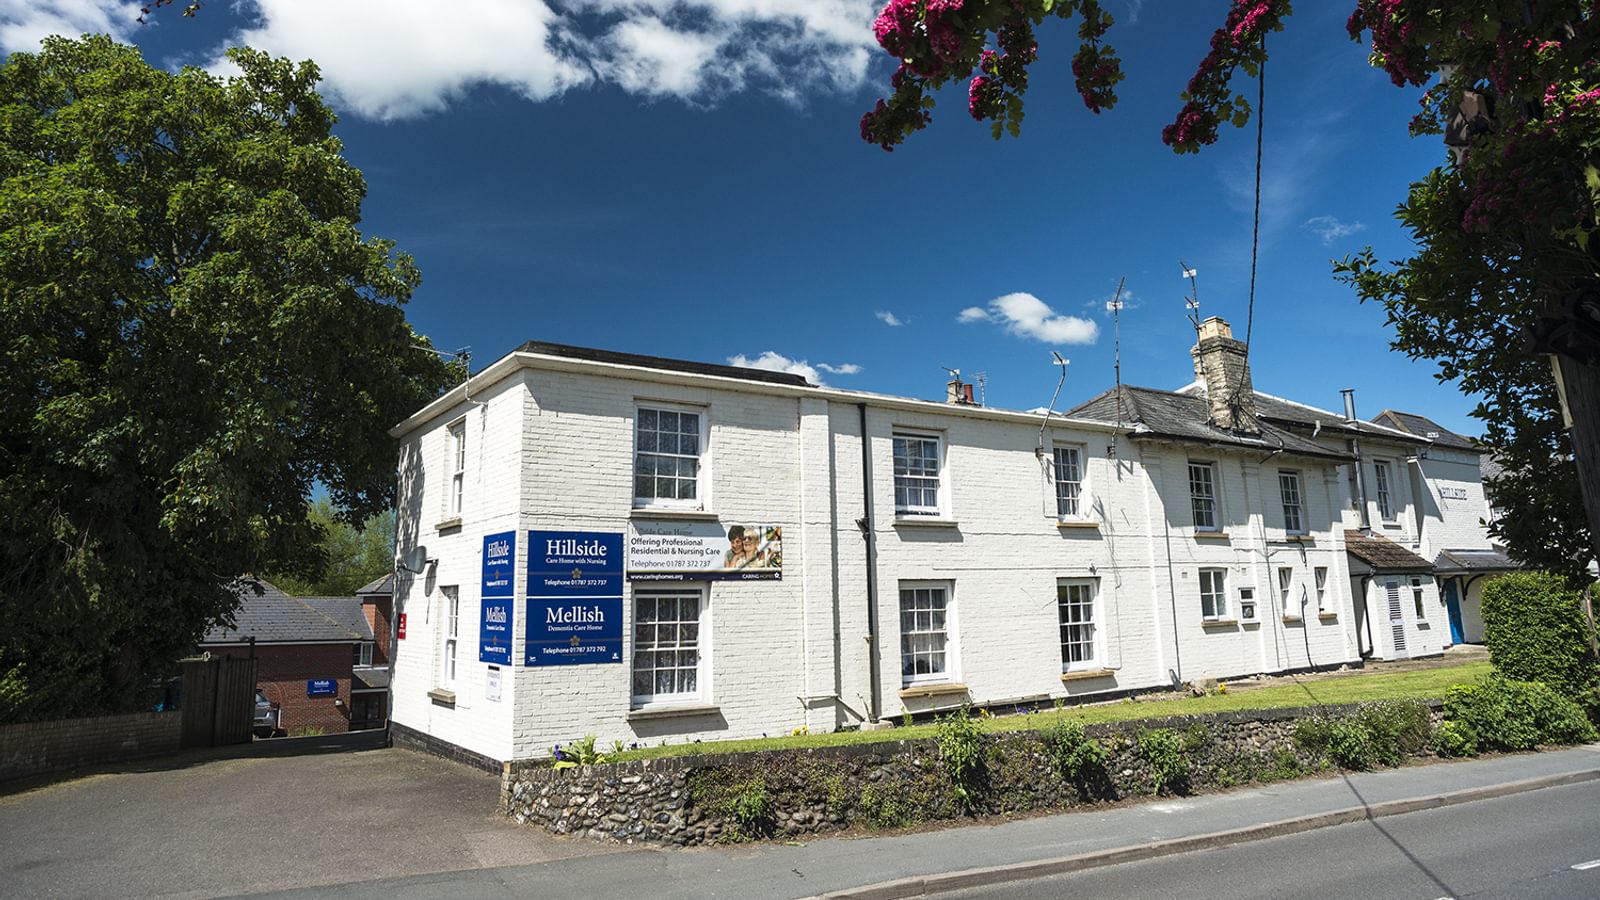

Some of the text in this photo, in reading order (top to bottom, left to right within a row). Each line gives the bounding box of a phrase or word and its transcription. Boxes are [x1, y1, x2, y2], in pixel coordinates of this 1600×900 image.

[657, 527, 672, 535] Care
[630, 538, 703, 547] Offering Professional
[488, 540, 510, 558] Hillside
[546, 539, 607, 556] Hillside
[630, 547, 670, 555] Residential
[670, 547, 676, 555] &
[677, 548, 704, 556] Nursing
[587, 558, 607, 566] Nursing
[630, 559, 711, 568] Telephone 01787 372 737
[544, 579, 570, 587] Telephone
[486, 606, 507, 623] Mellish
[545, 605, 604, 623] Mellish
[542, 647, 569, 655] Telephone
